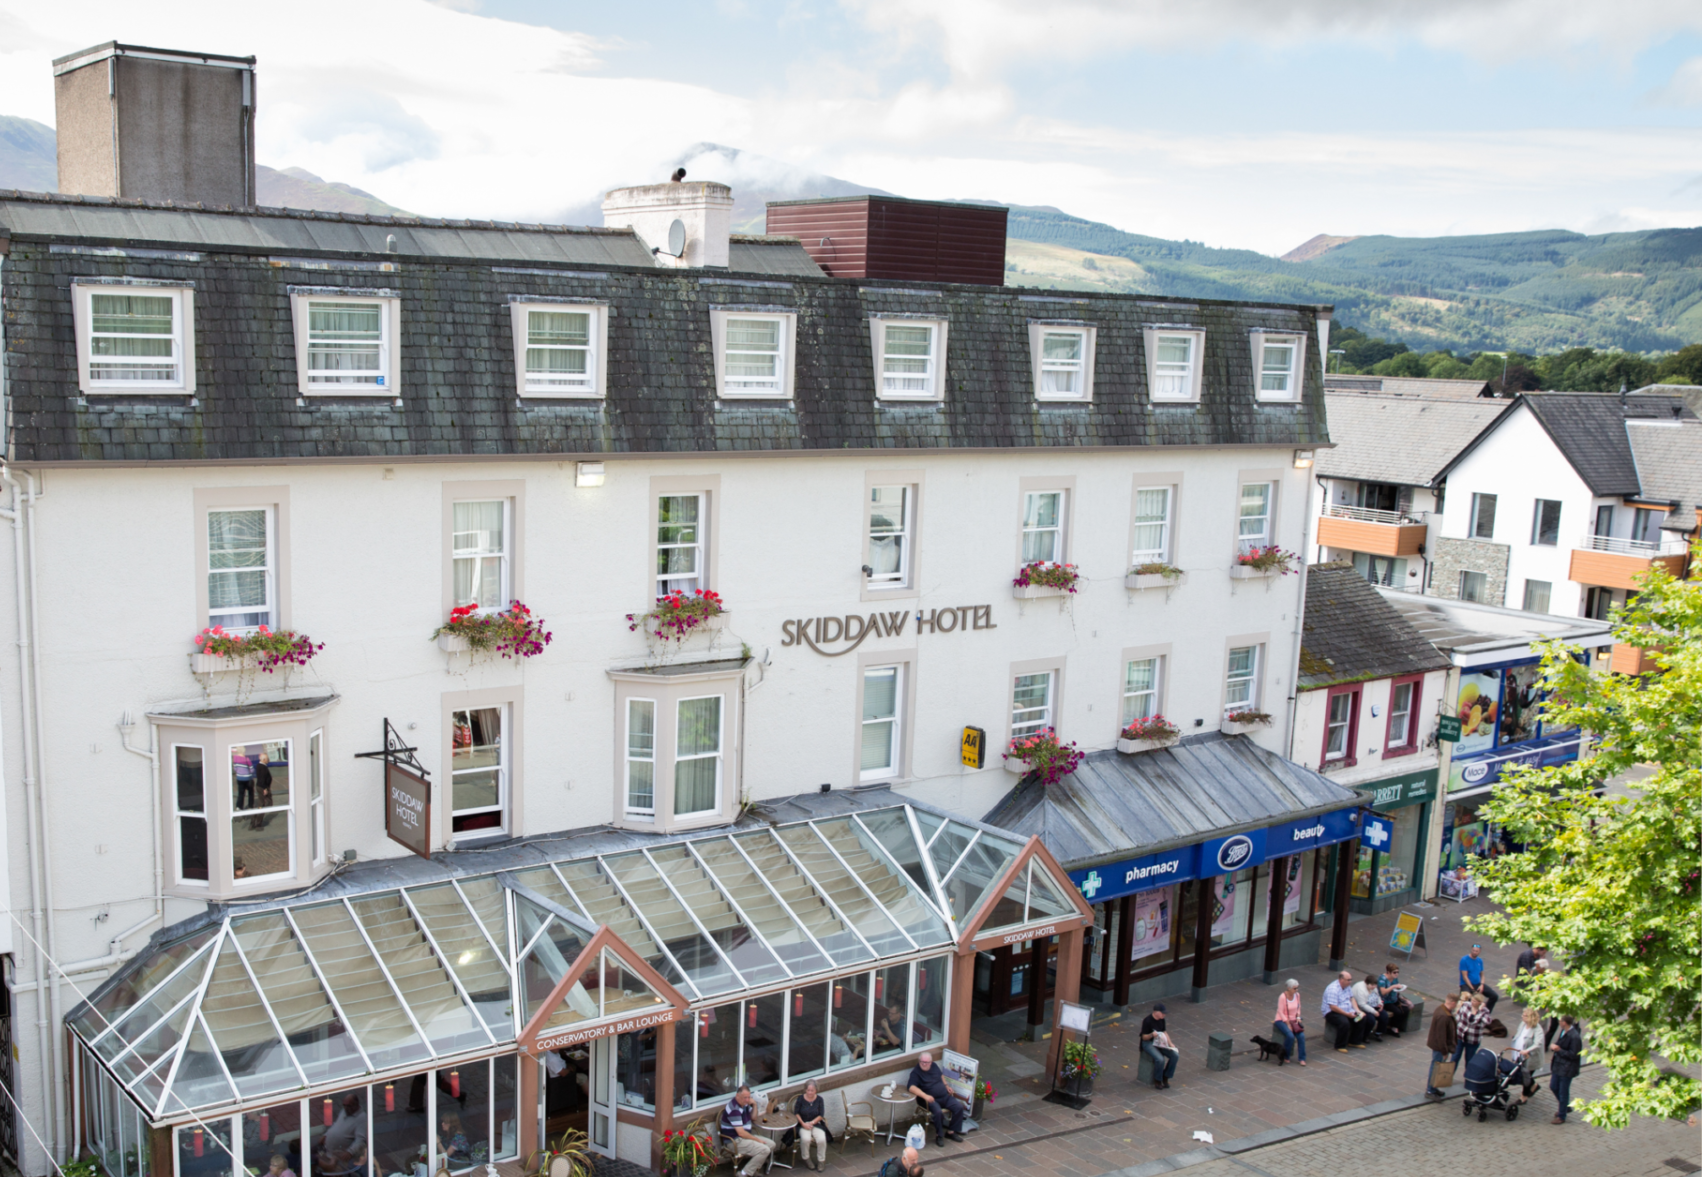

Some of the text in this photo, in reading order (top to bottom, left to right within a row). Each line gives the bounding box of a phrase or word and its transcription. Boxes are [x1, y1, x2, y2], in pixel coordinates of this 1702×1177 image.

[781, 604, 997, 656] SKIDDAW HOTEL
[963, 734, 977, 748] AA
[1467, 766, 1485, 777] Mace
[391, 786, 424, 813] SKIDDAW
[1372, 784, 1403, 803] ARRETT
[396, 803, 419, 827] HOTEL
[1292, 823, 1326, 841] beauty
[1224, 843, 1248, 865] Boots
[1125, 859, 1180, 884] pharmacy
[1003, 925, 1057, 944] SKIDDAW HOTEL
[536, 1011, 674, 1051] CONSERVATORY & BAR LOUNGE
